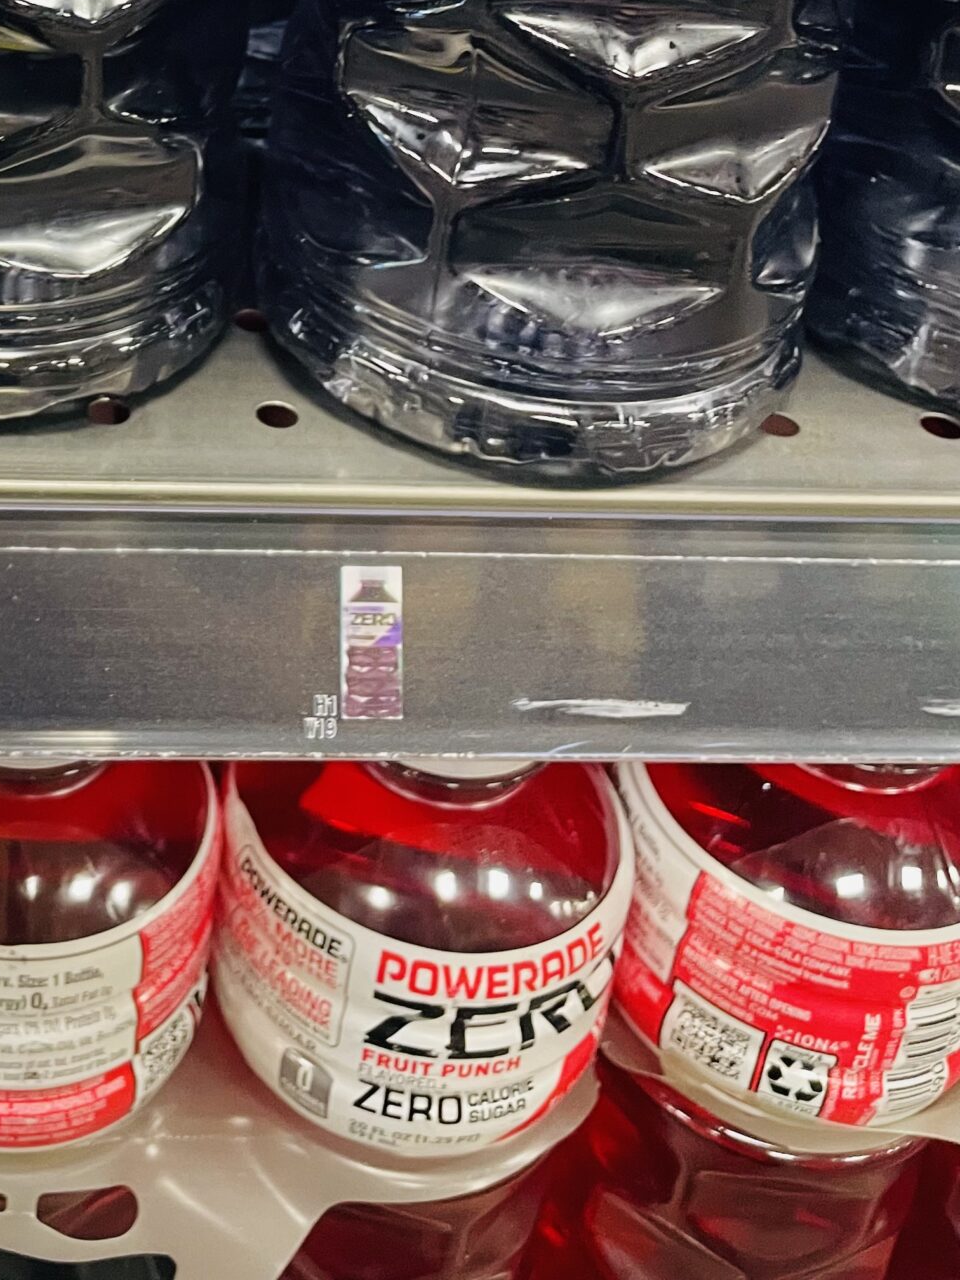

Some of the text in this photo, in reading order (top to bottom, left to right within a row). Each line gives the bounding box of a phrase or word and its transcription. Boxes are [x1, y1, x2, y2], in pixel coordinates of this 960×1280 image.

[349, 612, 396, 627] ZERO
[240, 856, 344, 956] POWERADE
[375, 922, 606, 1000] POWERADE
[360, 1047, 522, 1078] FRUIT PUNCH
[353, 1078, 463, 1125] ZERO
[467, 1077, 536, 1107] CALORIE
[469, 1098, 527, 1124] SUGAR
